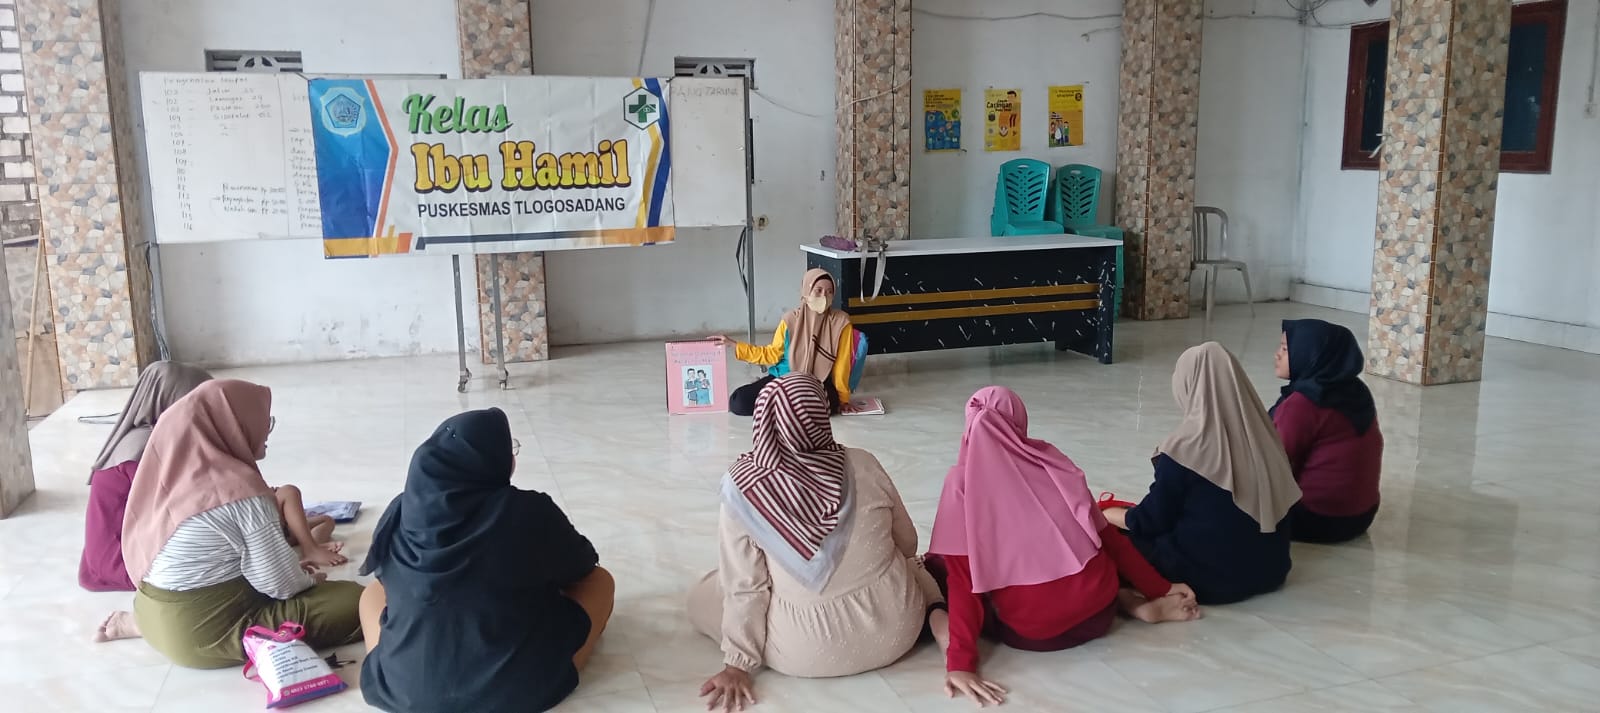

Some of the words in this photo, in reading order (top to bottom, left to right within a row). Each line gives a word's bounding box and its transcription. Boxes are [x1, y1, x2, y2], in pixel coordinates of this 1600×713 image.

[402, 93, 513, 134] Kelas
[410, 142, 492, 194] Ibu
[499, 139, 631, 191] Hamil
[418, 202, 511, 218] PUSKESMAS
[515, 197, 625, 215] TLOGOSADANG
